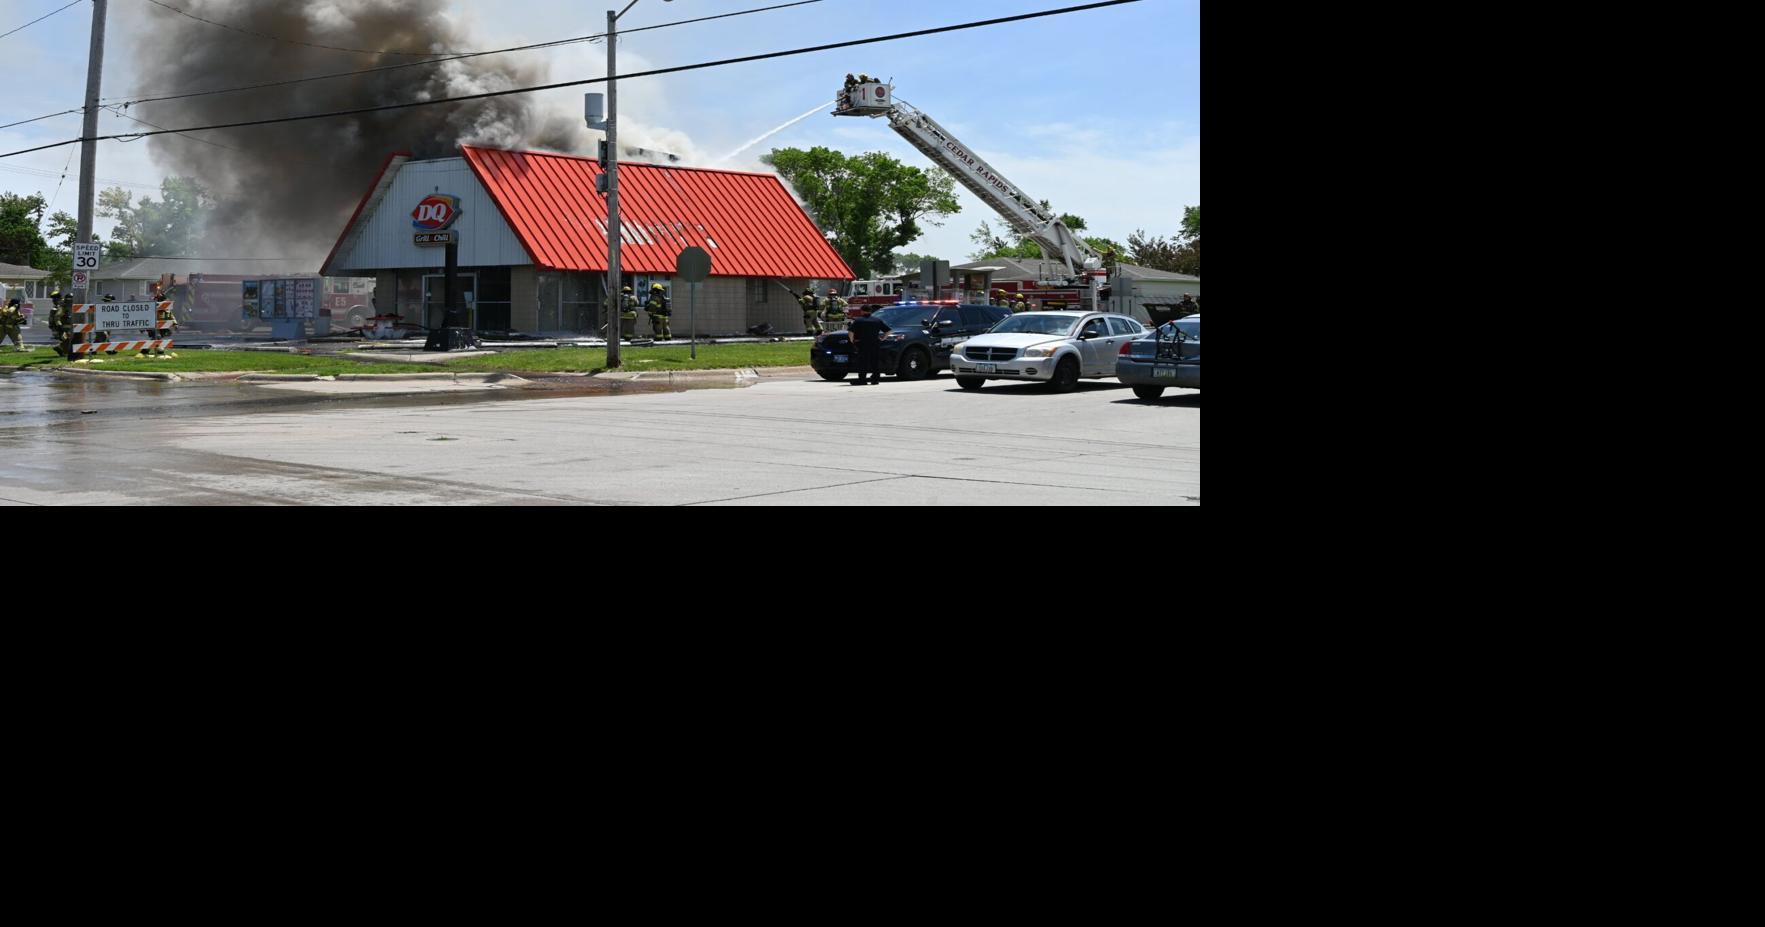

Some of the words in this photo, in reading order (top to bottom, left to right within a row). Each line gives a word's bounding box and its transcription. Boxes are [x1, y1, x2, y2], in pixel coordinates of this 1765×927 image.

[946, 142, 975, 166] CEDAR
[976, 166, 1009, 192] RAPIDS
[418, 203, 447, 222] DQ
[76, 257, 96, 267] 30
